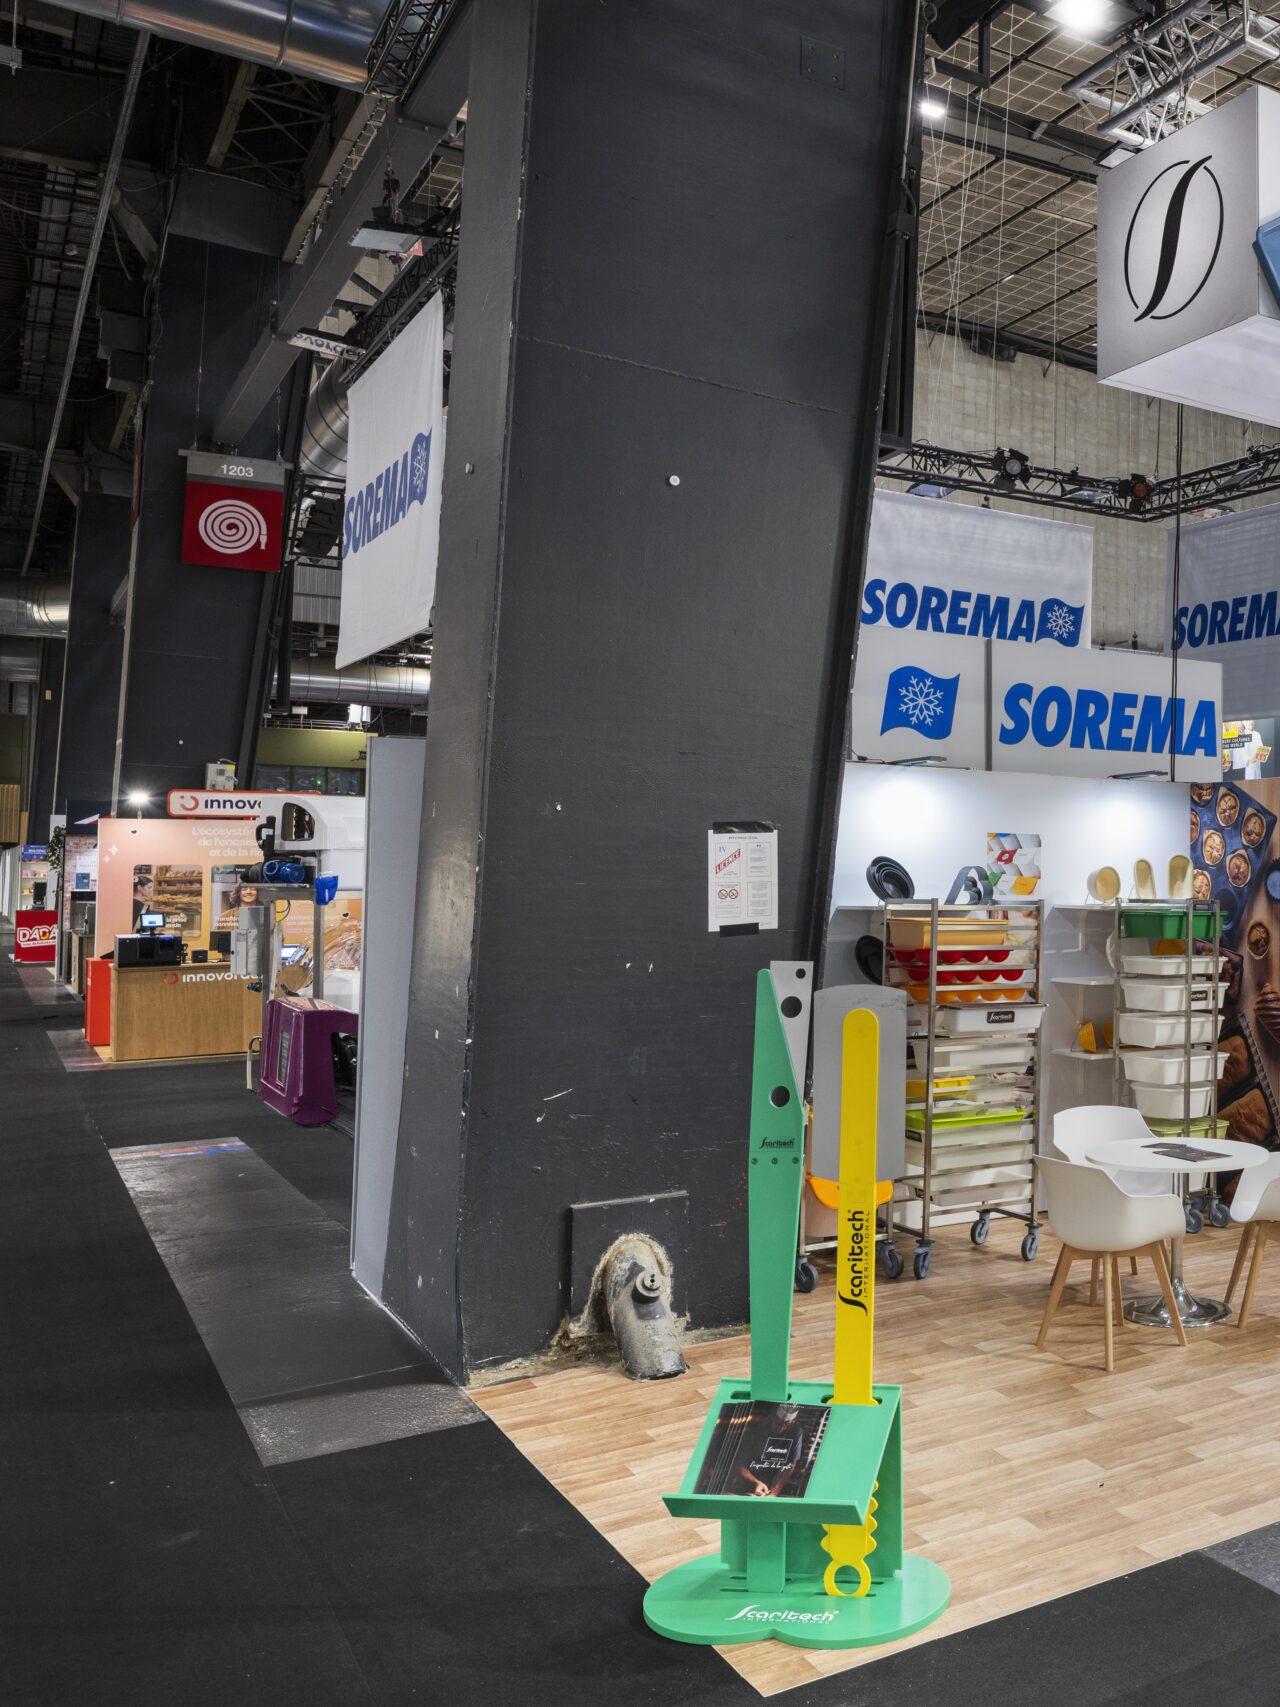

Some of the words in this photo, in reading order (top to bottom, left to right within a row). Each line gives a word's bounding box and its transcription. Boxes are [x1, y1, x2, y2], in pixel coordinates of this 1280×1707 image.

[220, 464, 254, 478] 1203
[342, 451, 409, 560] SOREMA
[861, 578, 1036, 643] SOREMA
[998, 682, 1218, 757] SOREMA
[760, 1136, 795, 1149] Scaritech
[743, 1617, 830, 1625] INTERNATIONAL
